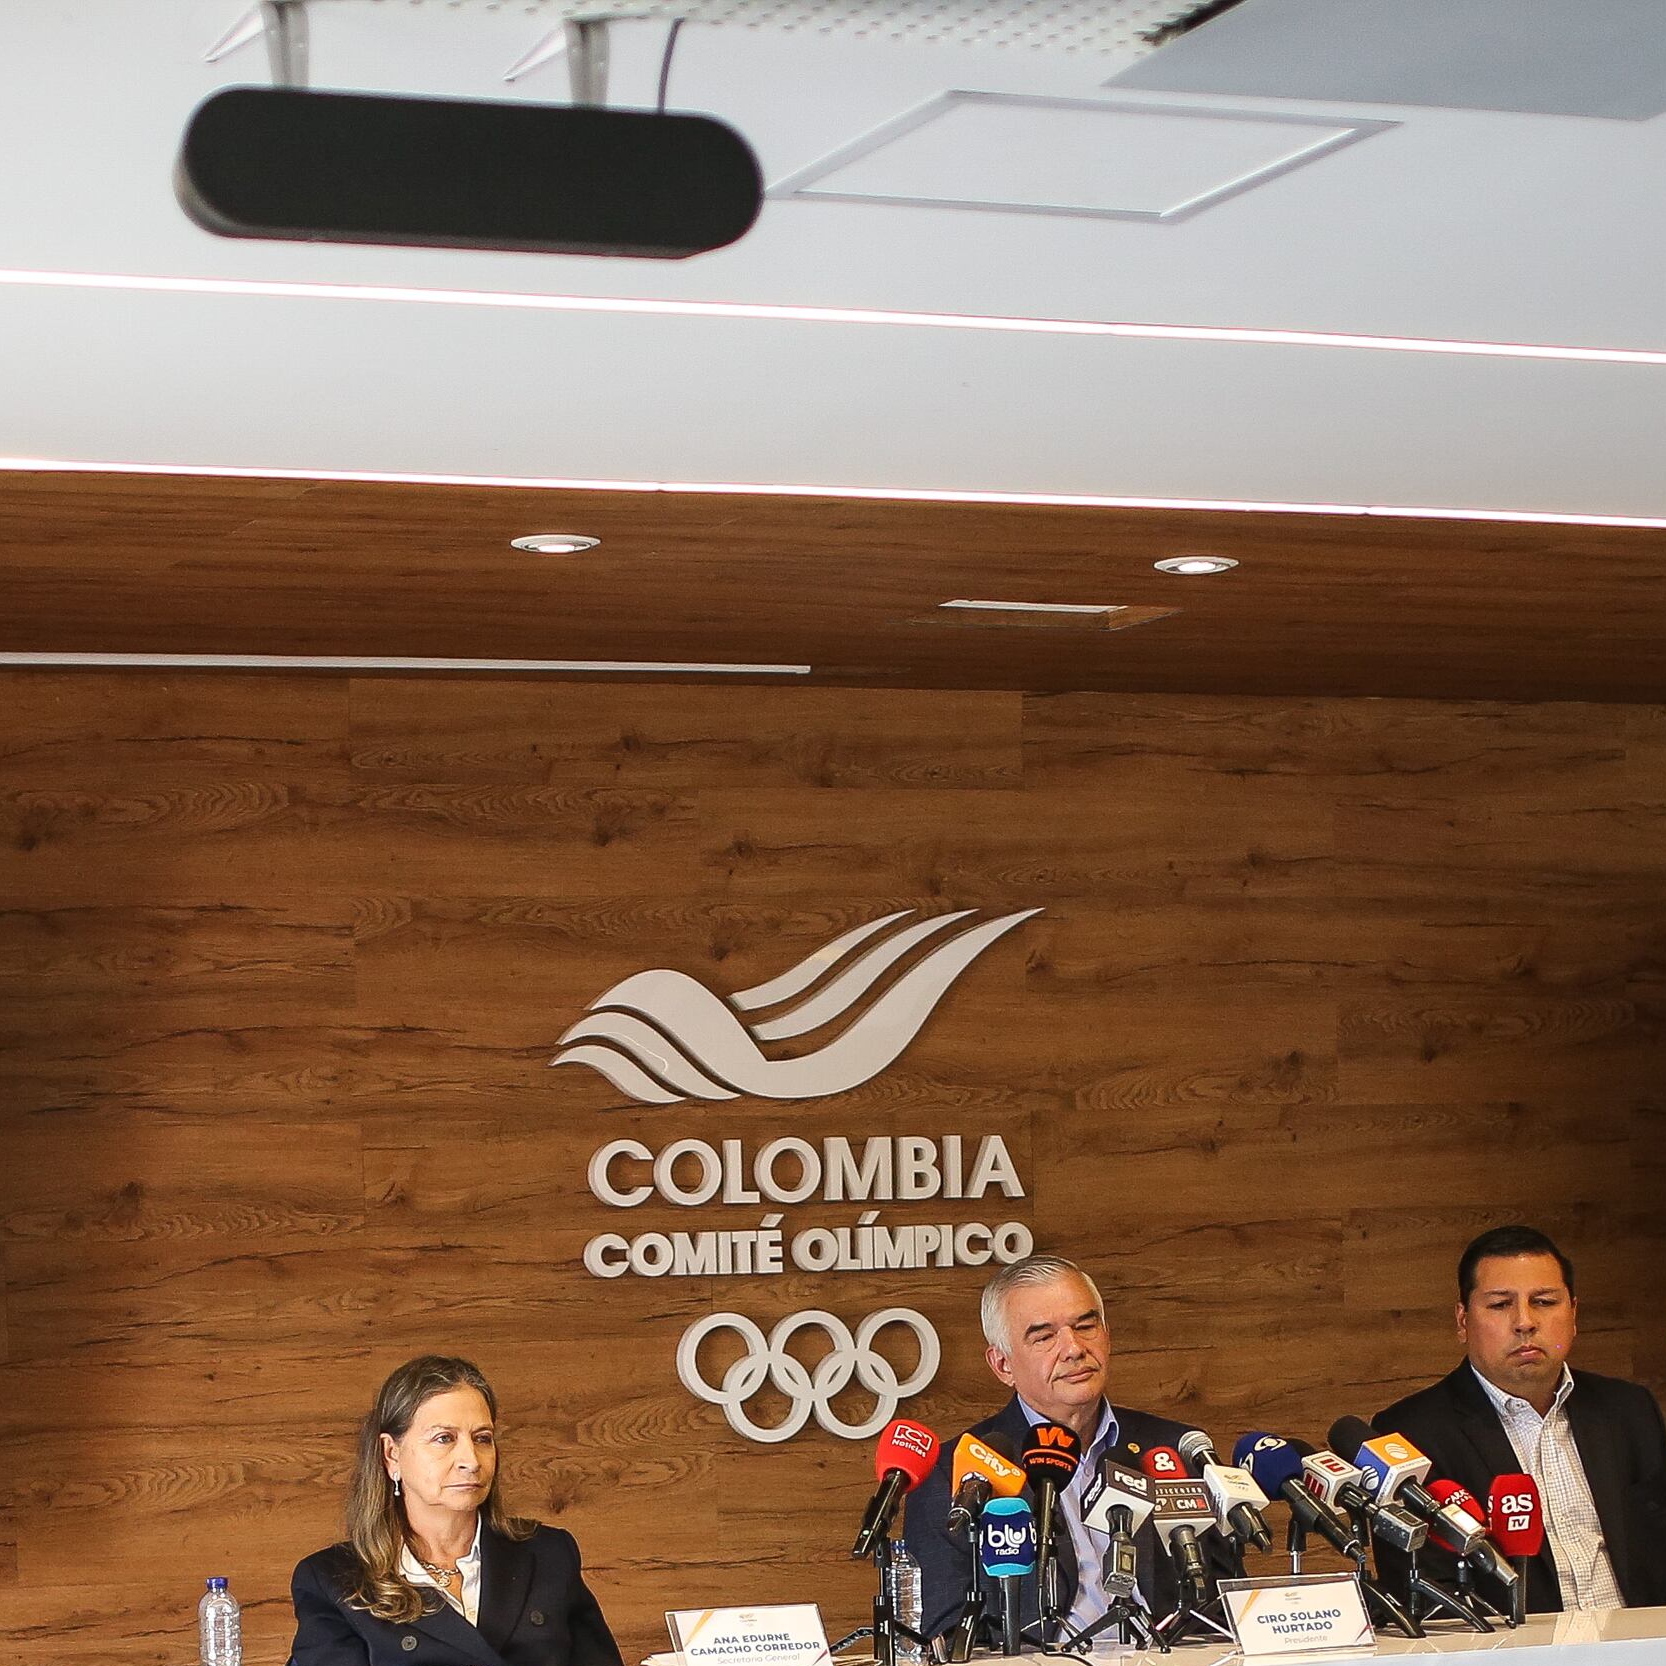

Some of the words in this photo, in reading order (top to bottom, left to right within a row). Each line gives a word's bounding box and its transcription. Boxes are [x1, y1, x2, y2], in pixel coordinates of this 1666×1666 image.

[587, 1134, 1026, 1207] COLOMBIA
[583, 1213, 784, 1278] COMITÉ
[791, 1211, 1034, 1272] OLÍMPICO
[892, 1438, 927, 1458] Noticias
[1029, 1457, 1045, 1465] WIN
[1045, 1457, 1073, 1472] SPORTS
[1114, 1470, 1147, 1491] red
[1501, 1493, 1532, 1514] as
[1511, 1517, 1528, 1528] TV
[988, 1524, 1026, 1549] blu
[995, 1547, 1020, 1556] radio
[1257, 1614, 1287, 1624] CIRO
[1290, 1609, 1341, 1621] SOLANO
[1272, 1621, 1333, 1634] HURTADO
[713, 1636, 740, 1645] ANA
[742, 1633, 791, 1643] EDURNE
[1284, 1635, 1328, 1645] Presidente
[690, 1645, 751, 1656] CAMACHO
[755, 1641, 821, 1652] CORREDOR
[765, 1653, 801, 1662] General
